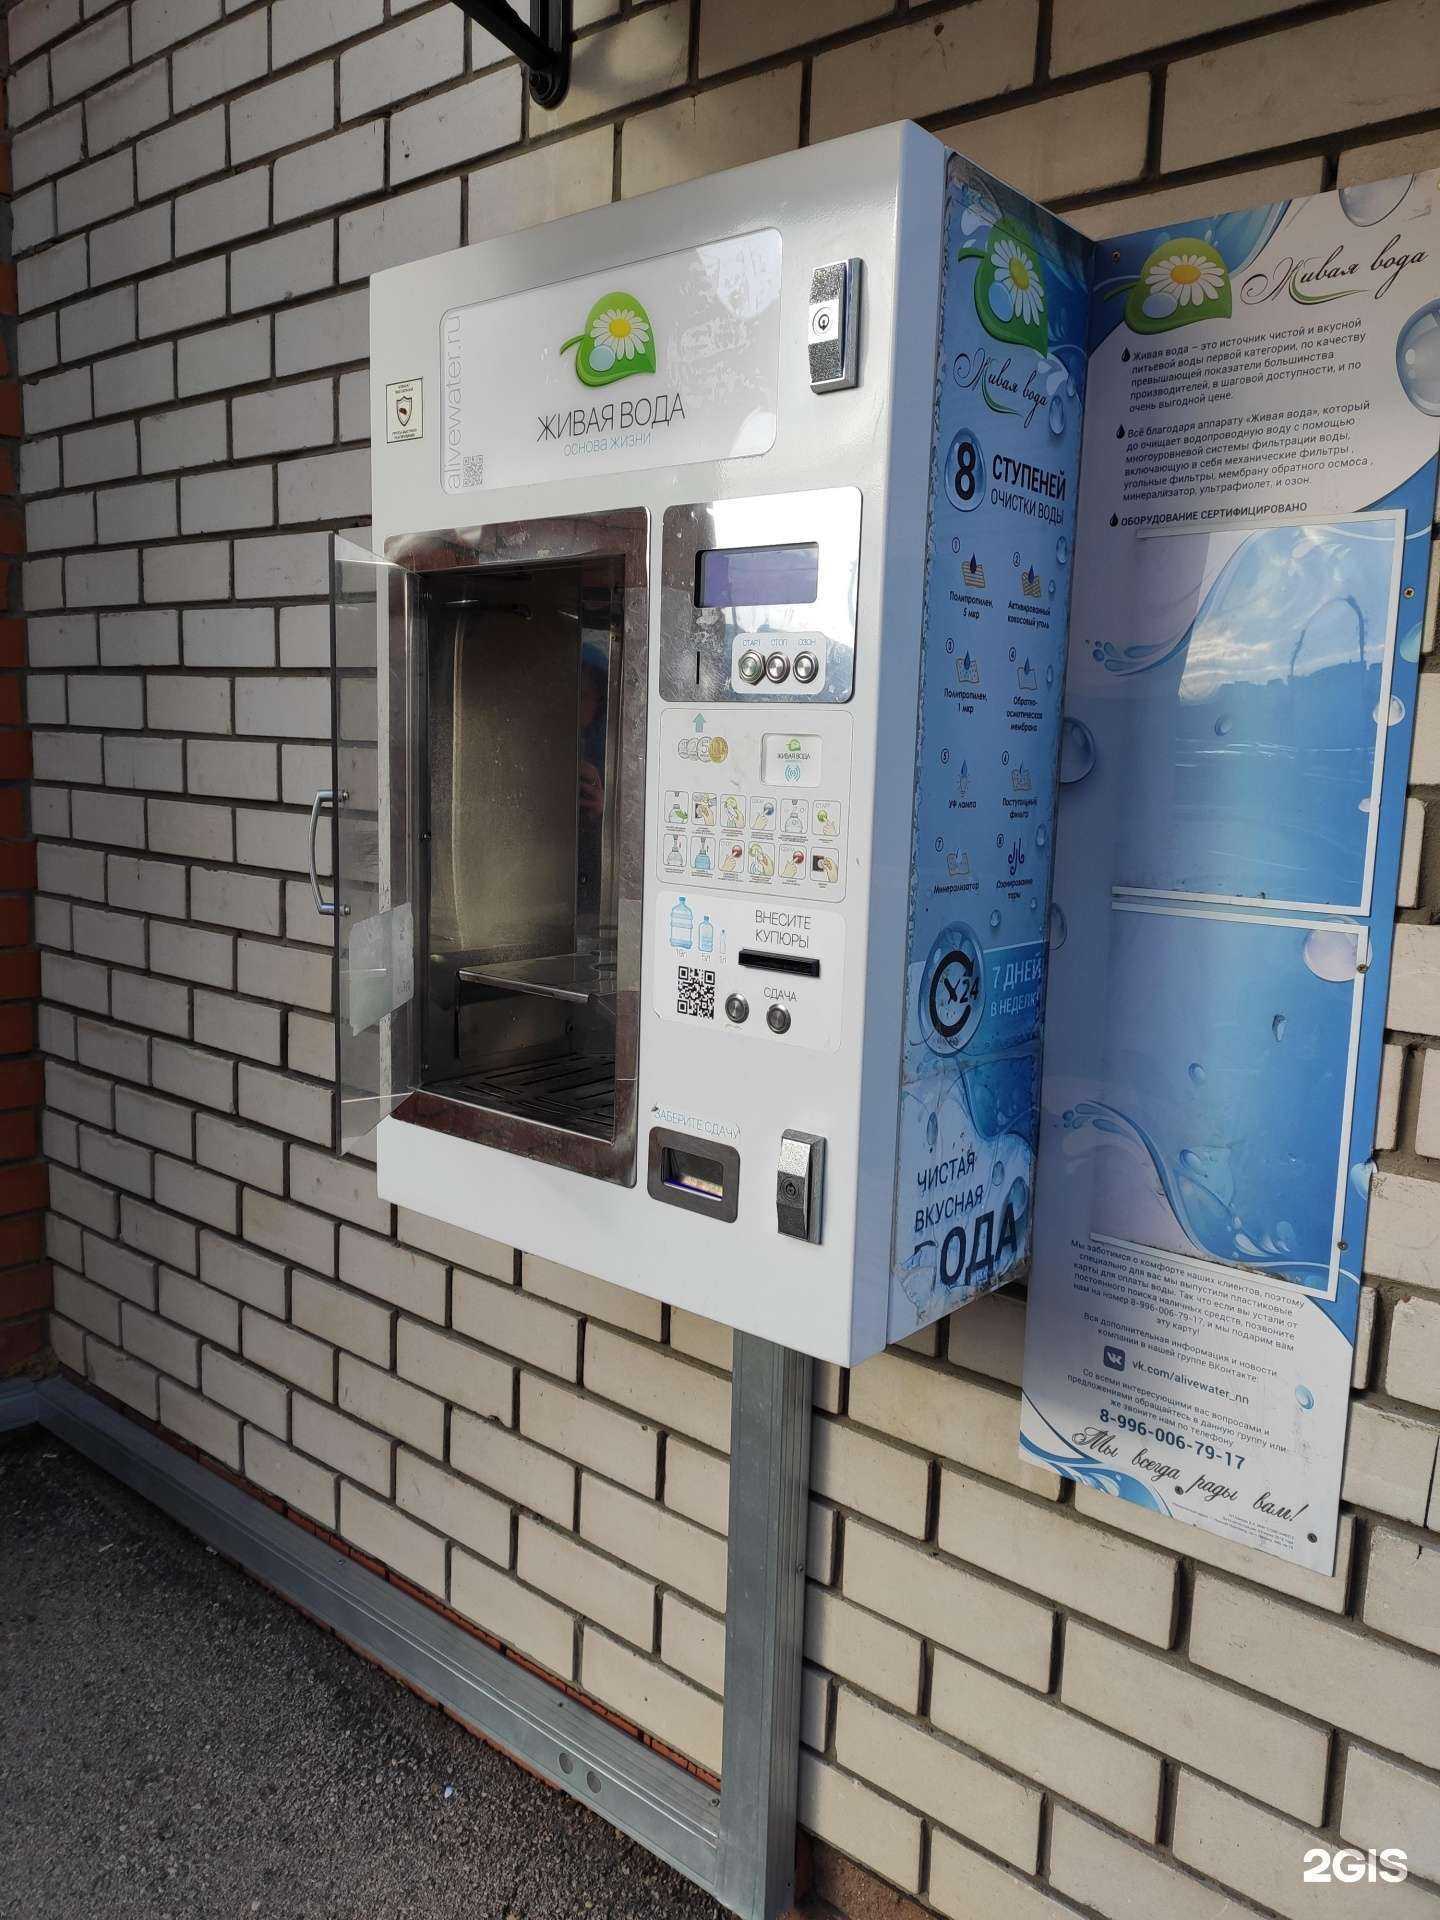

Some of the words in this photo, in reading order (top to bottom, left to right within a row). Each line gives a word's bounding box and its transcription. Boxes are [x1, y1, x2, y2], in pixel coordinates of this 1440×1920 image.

[1240, 245, 1362, 305] Живая
[1370, 234, 1429, 300] вода
[1132, 350, 1164, 360] Живая
[1166, 346, 1188, 355] вода
[1200, 341, 1217, 350] это
[1219, 334, 1265, 347] источник
[1270, 326, 1304, 339] чистой
[1317, 318, 1360, 332] вкусной
[1132, 359, 1174, 374] питьевой
[1176, 357, 1202, 367] воды
[1206, 349, 1240, 362] первой
[1316, 333, 1366, 346] качеству
[953, 348, 1020, 413] Живая
[1023, 370, 1047, 428] вода
[1131, 368, 1200, 387] превышающей
[1204, 361, 1261, 376] показатели
[1264, 351, 1334, 367] большинства
[1221, 372, 1262, 386] шаговой
[444, 315, 462, 489] alivewater.ru
[536, 404, 614, 442] ЖИВАЯ
[620, 393, 686, 429] ВОДА
[1129, 402, 1156, 412] очень
[1158, 394, 1204, 408] выгодной
[1146, 423, 1194, 435] благодаря
[1198, 417, 1242, 428] аппарату
[1322, 400, 1369, 414] который
[1126, 446, 1202, 463] многоуровневой
[1205, 442, 1248, 454] системы
[1252, 436, 1315, 450] фильтрации
[1141, 438, 1180, 449] очищает
[1183, 428, 1262, 444] водопроводную
[1266, 425, 1290, 434] воду
[1302, 418, 1355, 430] помощью
[955, 442, 976, 500] 8
[992, 454, 1066, 501] СТУПЕНЕЙ
[1124, 462, 1189, 476] включающую
[1200, 457, 1222, 467] себя
[1225, 451, 1296, 464] механические
[1300, 446, 1348, 458] фильтры
[1124, 477, 1166, 490] угольные
[1218, 467, 1268, 478] мембрану
[1271, 462, 1324, 474] обратного
[1328, 458, 1368, 468] осмоса
[991, 488, 1036, 516] ОЧИСТКИ
[1038, 502, 1064, 525] ВОДЫ
[1121, 511, 1197, 526] ОБОРУДОВАНИЕ
[1201, 501, 1306, 519] СЕРТИФИЦИРОВАНО
[756, 910, 811, 930] ВНЕСИТЕ
[756, 928, 809, 948] КУПЮРЫ
[992, 966, 1001, 989] 7
[1003, 952, 1041, 991] ДНЕЙ
[764, 987, 796, 1002] СДАЧА
[918, 1152, 976, 1192] ЧИСТАЯ
[914, 1184, 984, 1233] ВКУСНАЯ
[914, 1202, 1018, 1285] ОДА
[1071, 1238, 1082, 1248] Мы
[1087, 1244, 1131, 1261] заботимся
[1141, 1259, 1184, 1275] комфорте
[1187, 1271, 1215, 1284] наших
[1264, 1292, 1305, 1309] поэтому
[1074, 1262, 1097, 1273] карты
[1100, 1269, 1116, 1278] для
[1119, 1274, 1147, 1287] оплаты
[1180, 1289, 1194, 1300] Так
[1197, 1296, 1211, 1305] что
[1214, 1301, 1234, 1311] если
[1252, 1311, 1285, 1325] устали
[1080, 1253, 1126, 1271] специально
[1129, 1267, 1144, 1276] для
[1147, 1271, 1161, 1280] вас
[1180, 1280, 1228, 1298] выпустили
[1231, 1294, 1293, 1315] пластиковые
[1073, 1283, 1089, 1292] нам
[1216, 1323, 1229, 1332] мы
[1232, 1328, 1272, 1345] подарим
[1275, 1342, 1294, 1352] вам
[1074, 1272, 1125, 1292] постоянного
[1128, 1288, 1157, 1301] поиска
[1159, 1297, 1201, 1313] наличных
[1245, 1321, 1295, 1339] позвоните
[1157, 1317, 1170, 1328] эту
[1084, 1311, 1098, 1322] Вся
[1100, 1318, 1170, 1344] дополнительная
[1172, 1340, 1229, 1362] информация
[1239, 1360, 1277, 1376] новости
[1098, 1328, 1139, 1345] компании
[1148, 1344, 1175, 1356] нашей
[1177, 1352, 1206, 1366] группе
[1209, 1360, 1257, 1381] ВКонтакте
[1082, 1367, 1092, 1377] Со
[1094, 1373, 1120, 1386] всеми
[1123, 1382, 1191, 1410] интересующими
[1194, 1406, 1210, 1416] вас
[1212, 1412, 1262, 1433] вопросами
[1132, 1360, 1249, 1404] vk.com/alivewater_nn
[1067, 1374, 1133, 1401] предложениями
[1135, 1397, 1192, 1421] обращайтесь
[1200, 1419, 1234, 1435] данную
[1240, 1432, 1267, 1448] группу
[1269, 1442, 1287, 1452] или
[1121, 1403, 1156, 1419] звоните
[1159, 1416, 1176, 1426] нам
[1191, 1427, 1234, 1448] телефону
[1100, 1409, 1246, 1468] 8-996-006-79-17
[1072, 1426, 1119, 1458] Мы
[1132, 1448, 1179, 1481] всегда
[1185, 1474, 1240, 1502] рады
[1253, 1490, 1309, 1522] вам!
